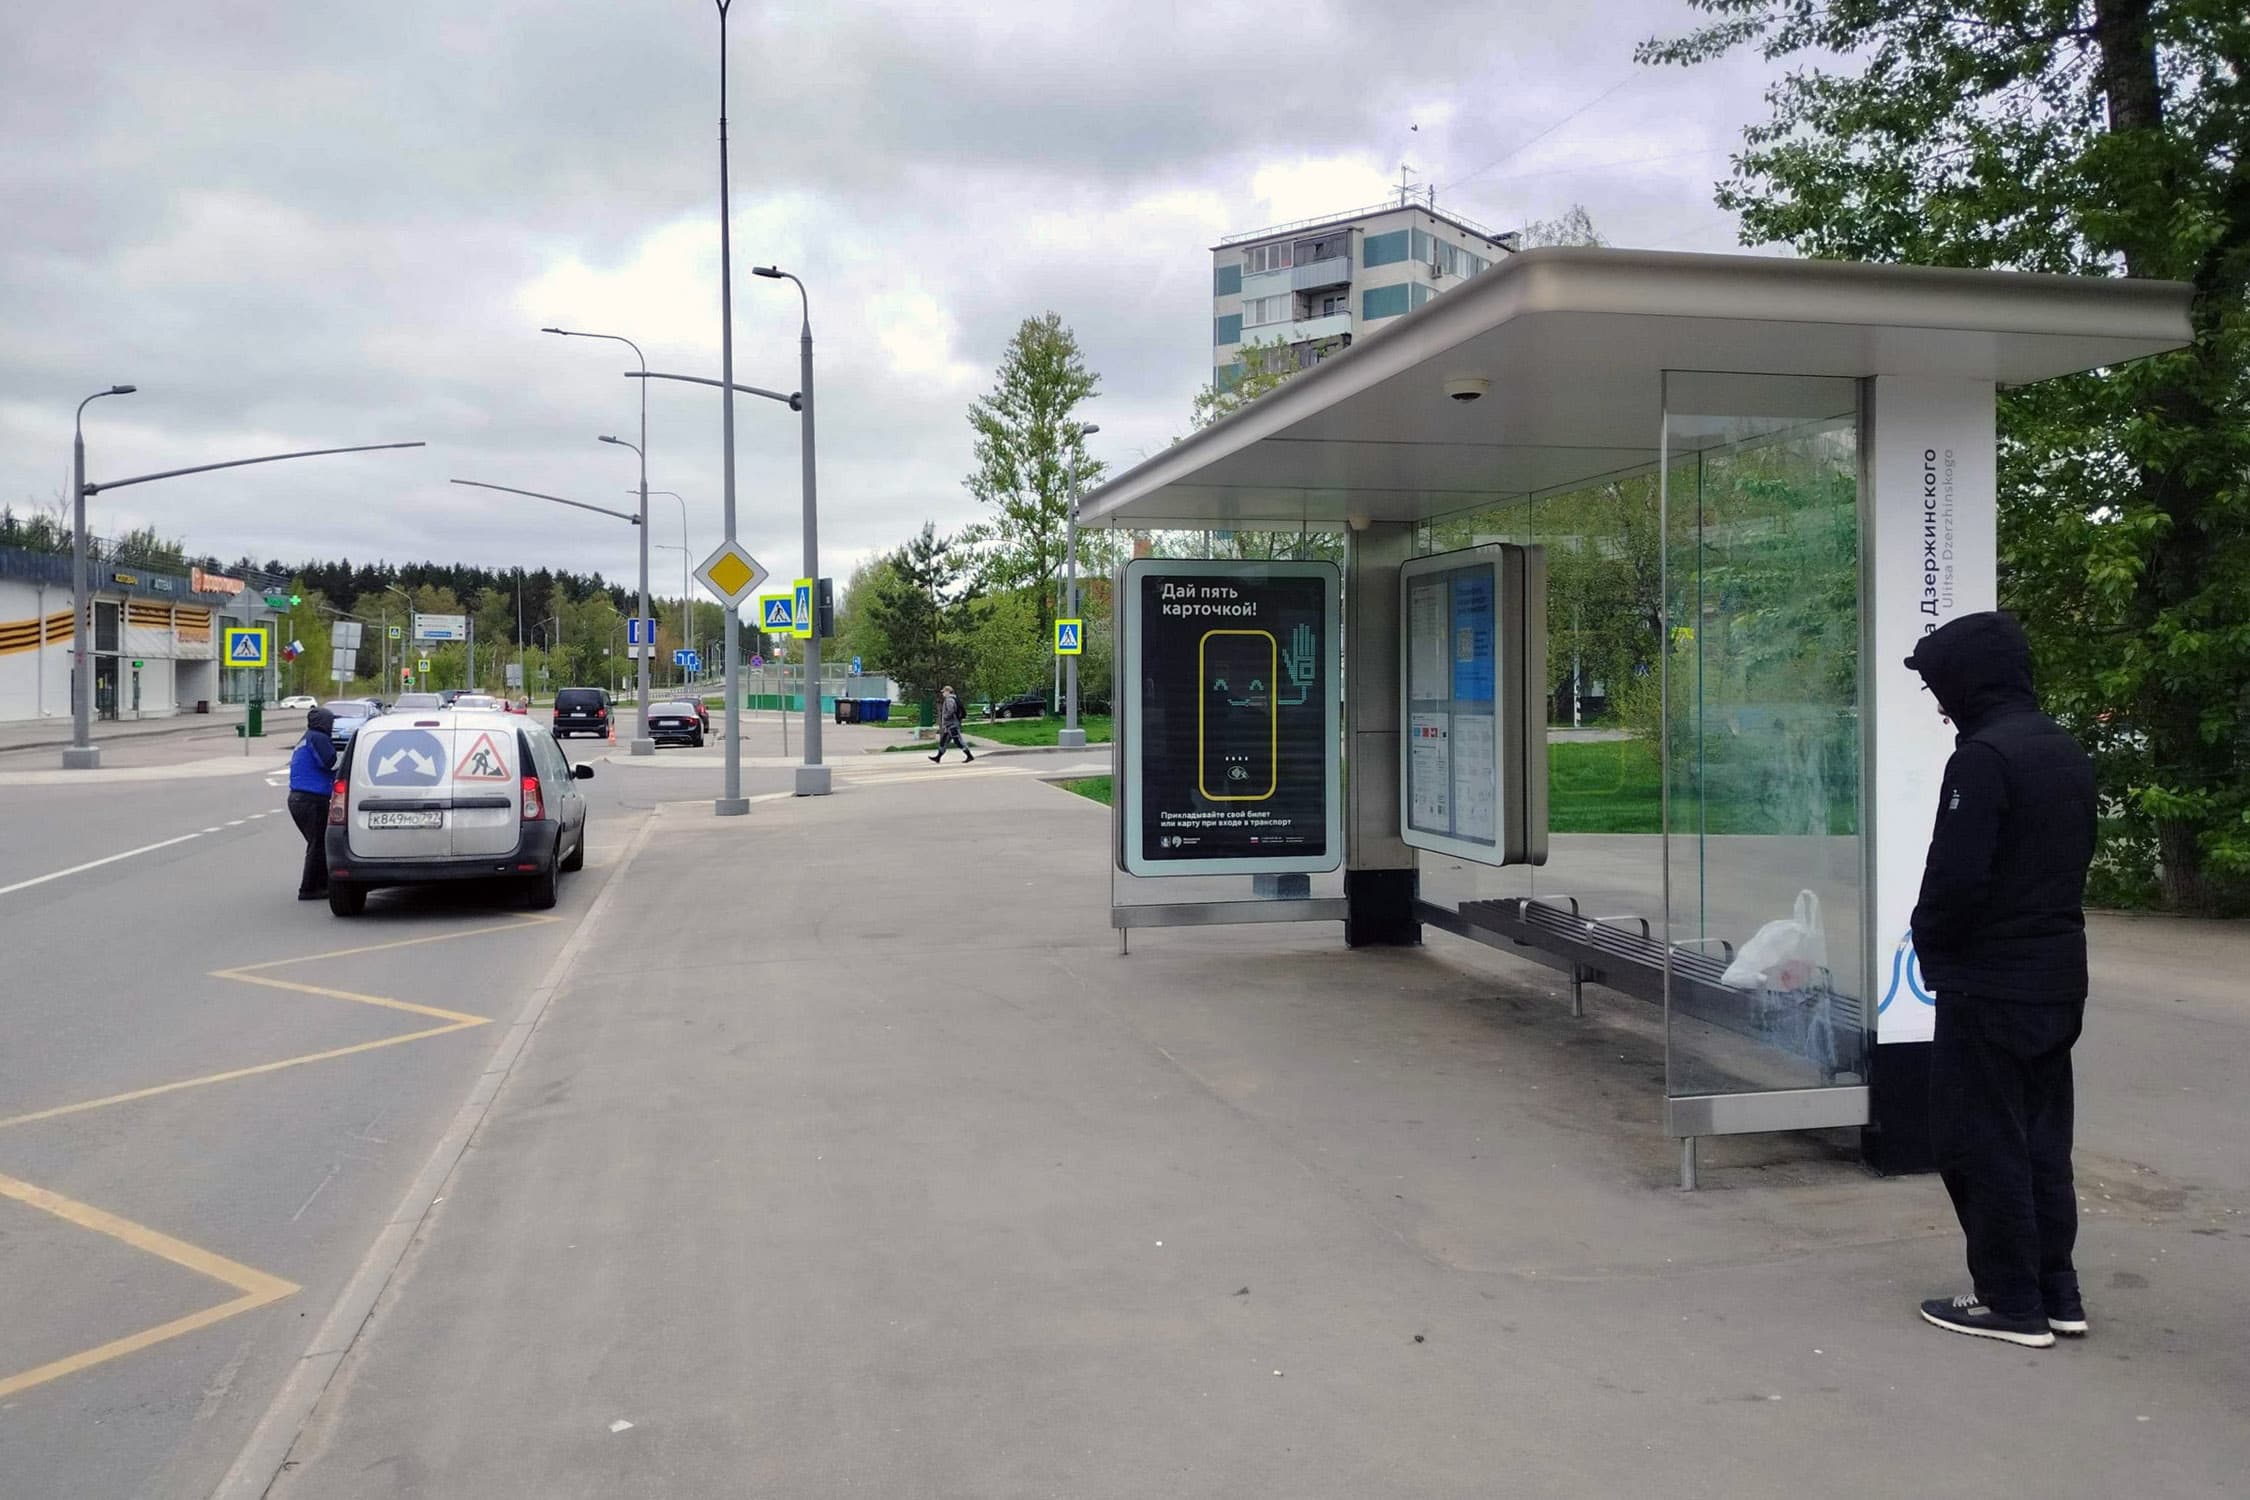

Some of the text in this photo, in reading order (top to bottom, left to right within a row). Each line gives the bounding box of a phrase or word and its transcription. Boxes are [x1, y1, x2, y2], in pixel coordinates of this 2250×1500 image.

[1921, 449, 1939, 616] Дзержинского
[1942, 449, 1955, 608] Ulitsa Dzerzhinskogo
[1162, 583, 1238, 600] Дай пять
[1162, 602, 1257, 619] карточкой!
[1160, 810, 1271, 820] Прикладывайте свой билет
[1177, 820, 1200, 828] карту
[1218, 819, 1242, 827] входе
[1250, 819, 1292, 827] транспорт
